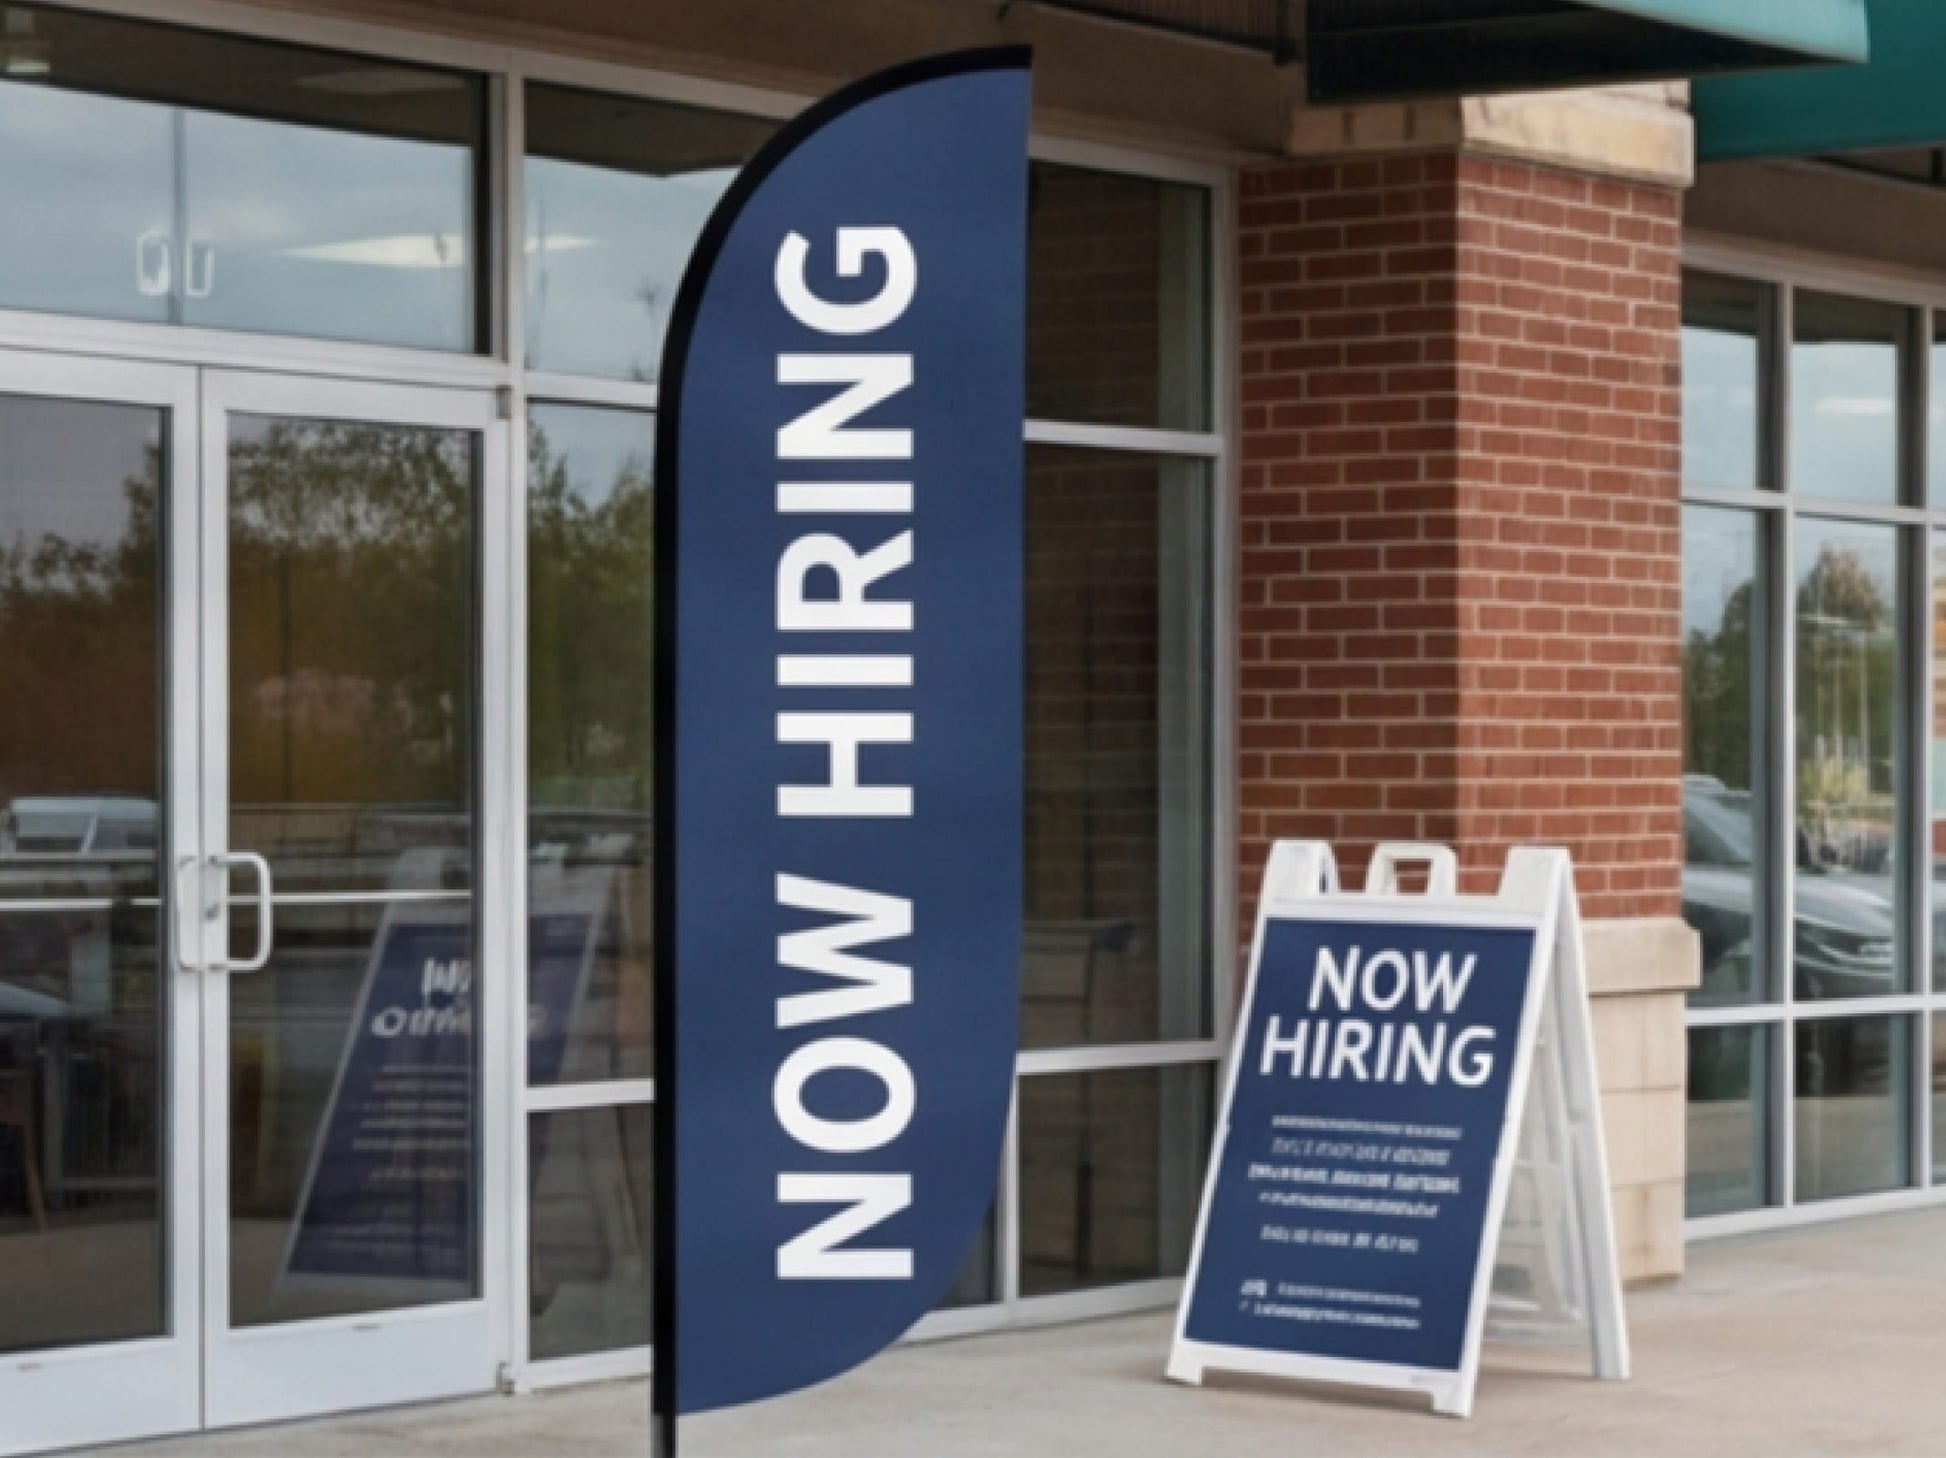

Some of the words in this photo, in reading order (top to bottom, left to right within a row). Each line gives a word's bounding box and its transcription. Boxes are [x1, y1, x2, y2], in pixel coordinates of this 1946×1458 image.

[773, 225, 918, 818] HIRING
[773, 872, 916, 1280] NOW
[1260, 1015, 1496, 1086] HIRING
[1308, 945, 1478, 1014] NOW
